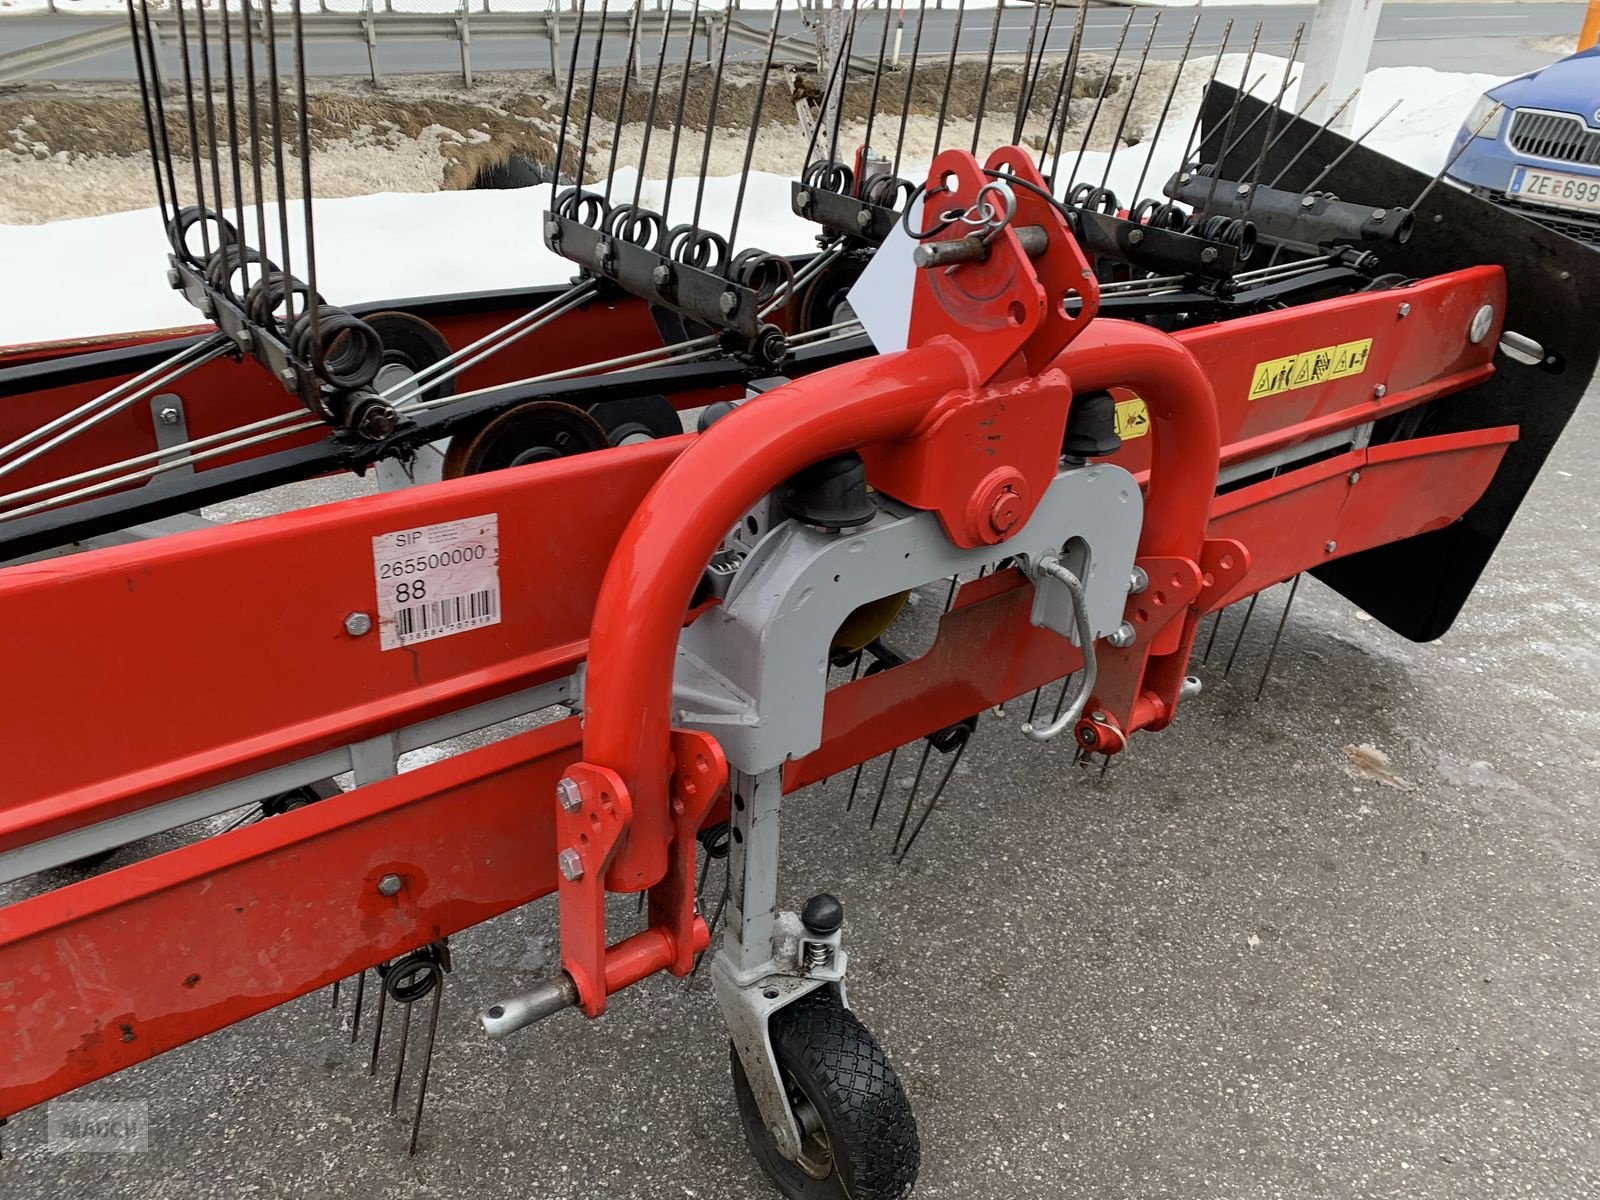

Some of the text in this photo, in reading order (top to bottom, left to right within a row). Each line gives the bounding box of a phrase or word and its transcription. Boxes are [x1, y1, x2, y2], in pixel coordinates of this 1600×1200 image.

[1527, 175, 1600, 202] ZE 699
[395, 531, 423, 547] SIP
[380, 545, 485, 579] 265500000
[395, 579, 426, 603] 88
